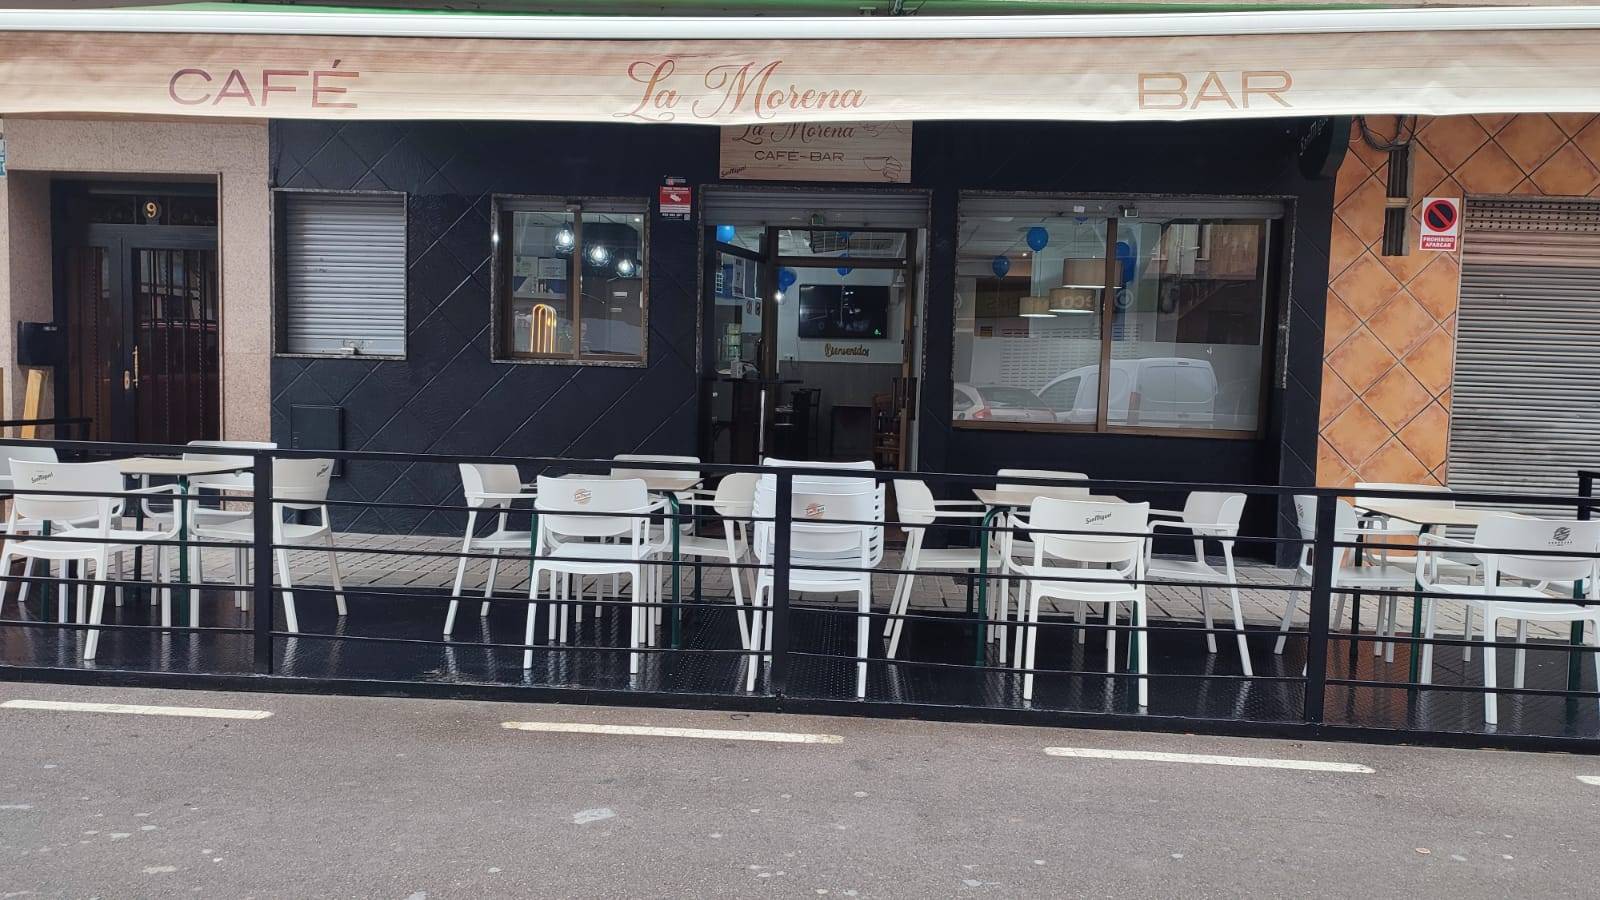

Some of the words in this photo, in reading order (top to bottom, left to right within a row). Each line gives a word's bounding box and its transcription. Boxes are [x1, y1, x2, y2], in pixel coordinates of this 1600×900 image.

[168, 59, 360, 109] CAFÉ
[613, 59, 682, 122] La
[692, 60, 867, 120] Morena
[1138, 70, 1294, 110] BAR
[146, 202, 156, 218] 9
